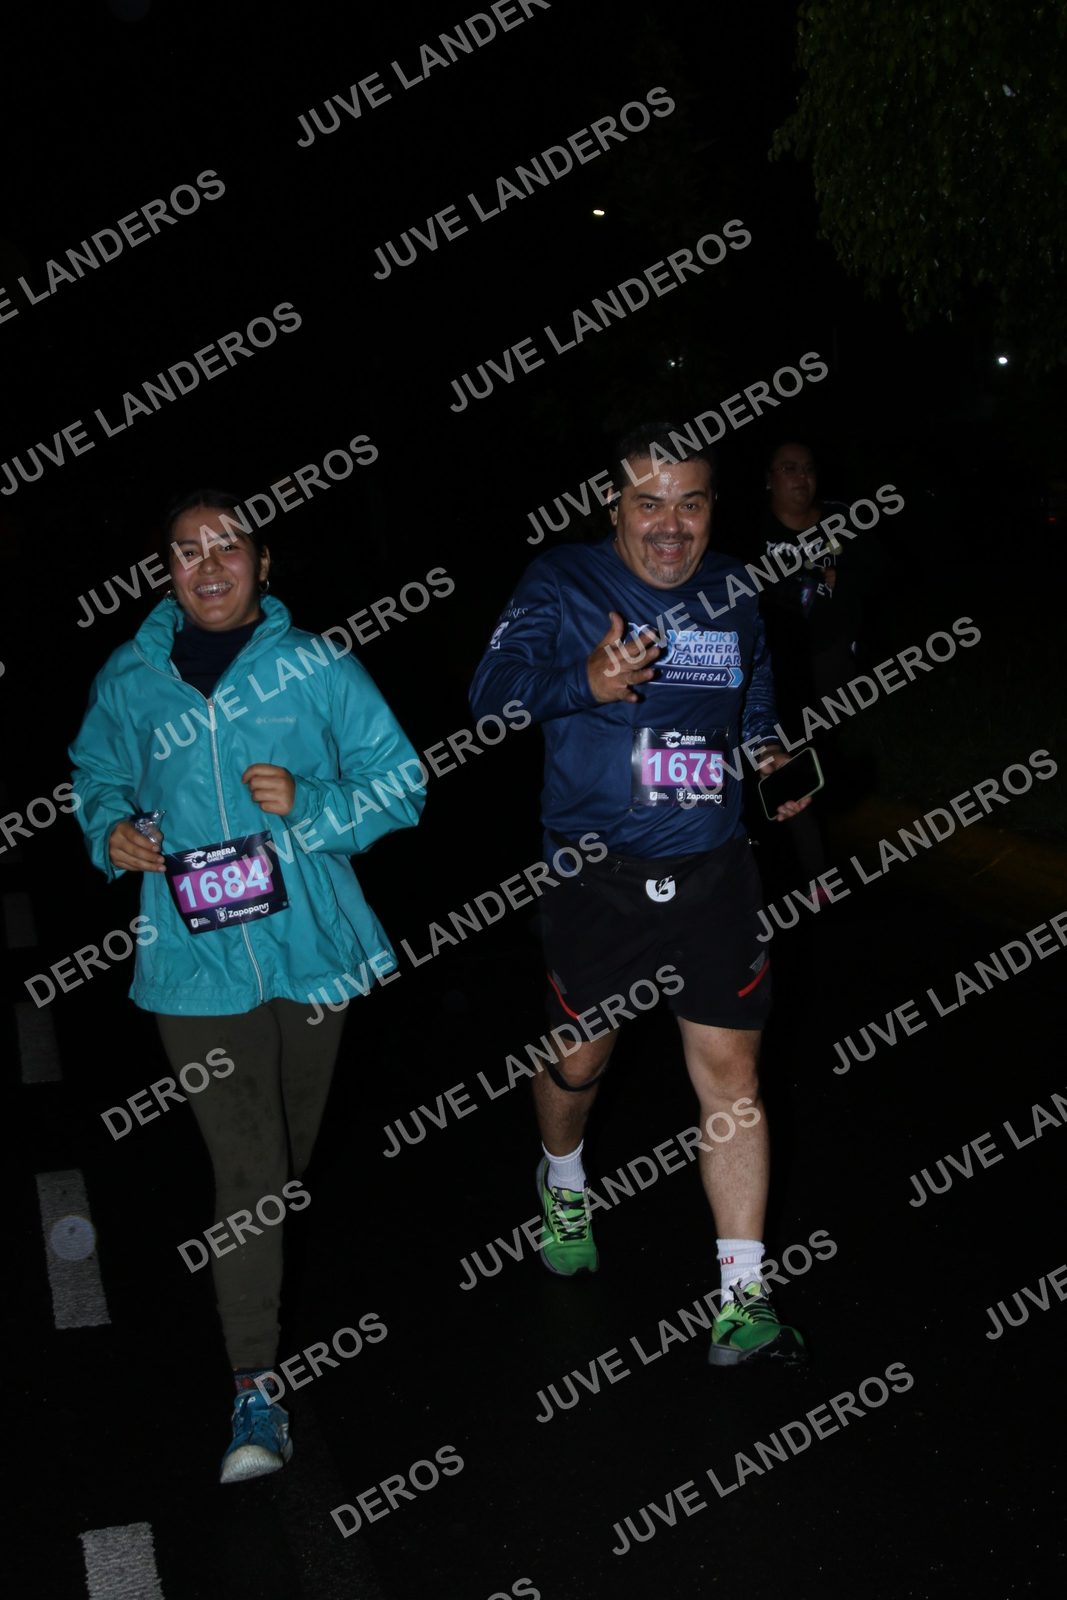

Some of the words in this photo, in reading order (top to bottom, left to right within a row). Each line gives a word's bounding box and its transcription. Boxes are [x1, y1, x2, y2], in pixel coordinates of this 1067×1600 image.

[674, 644, 739, 654] CARRERA
[674, 652, 741, 665] FAMILIAR
[666, 670, 727, 682] UNIVERSAL
[648, 752, 724, 783] 1675
[179, 859, 270, 908] 1684
